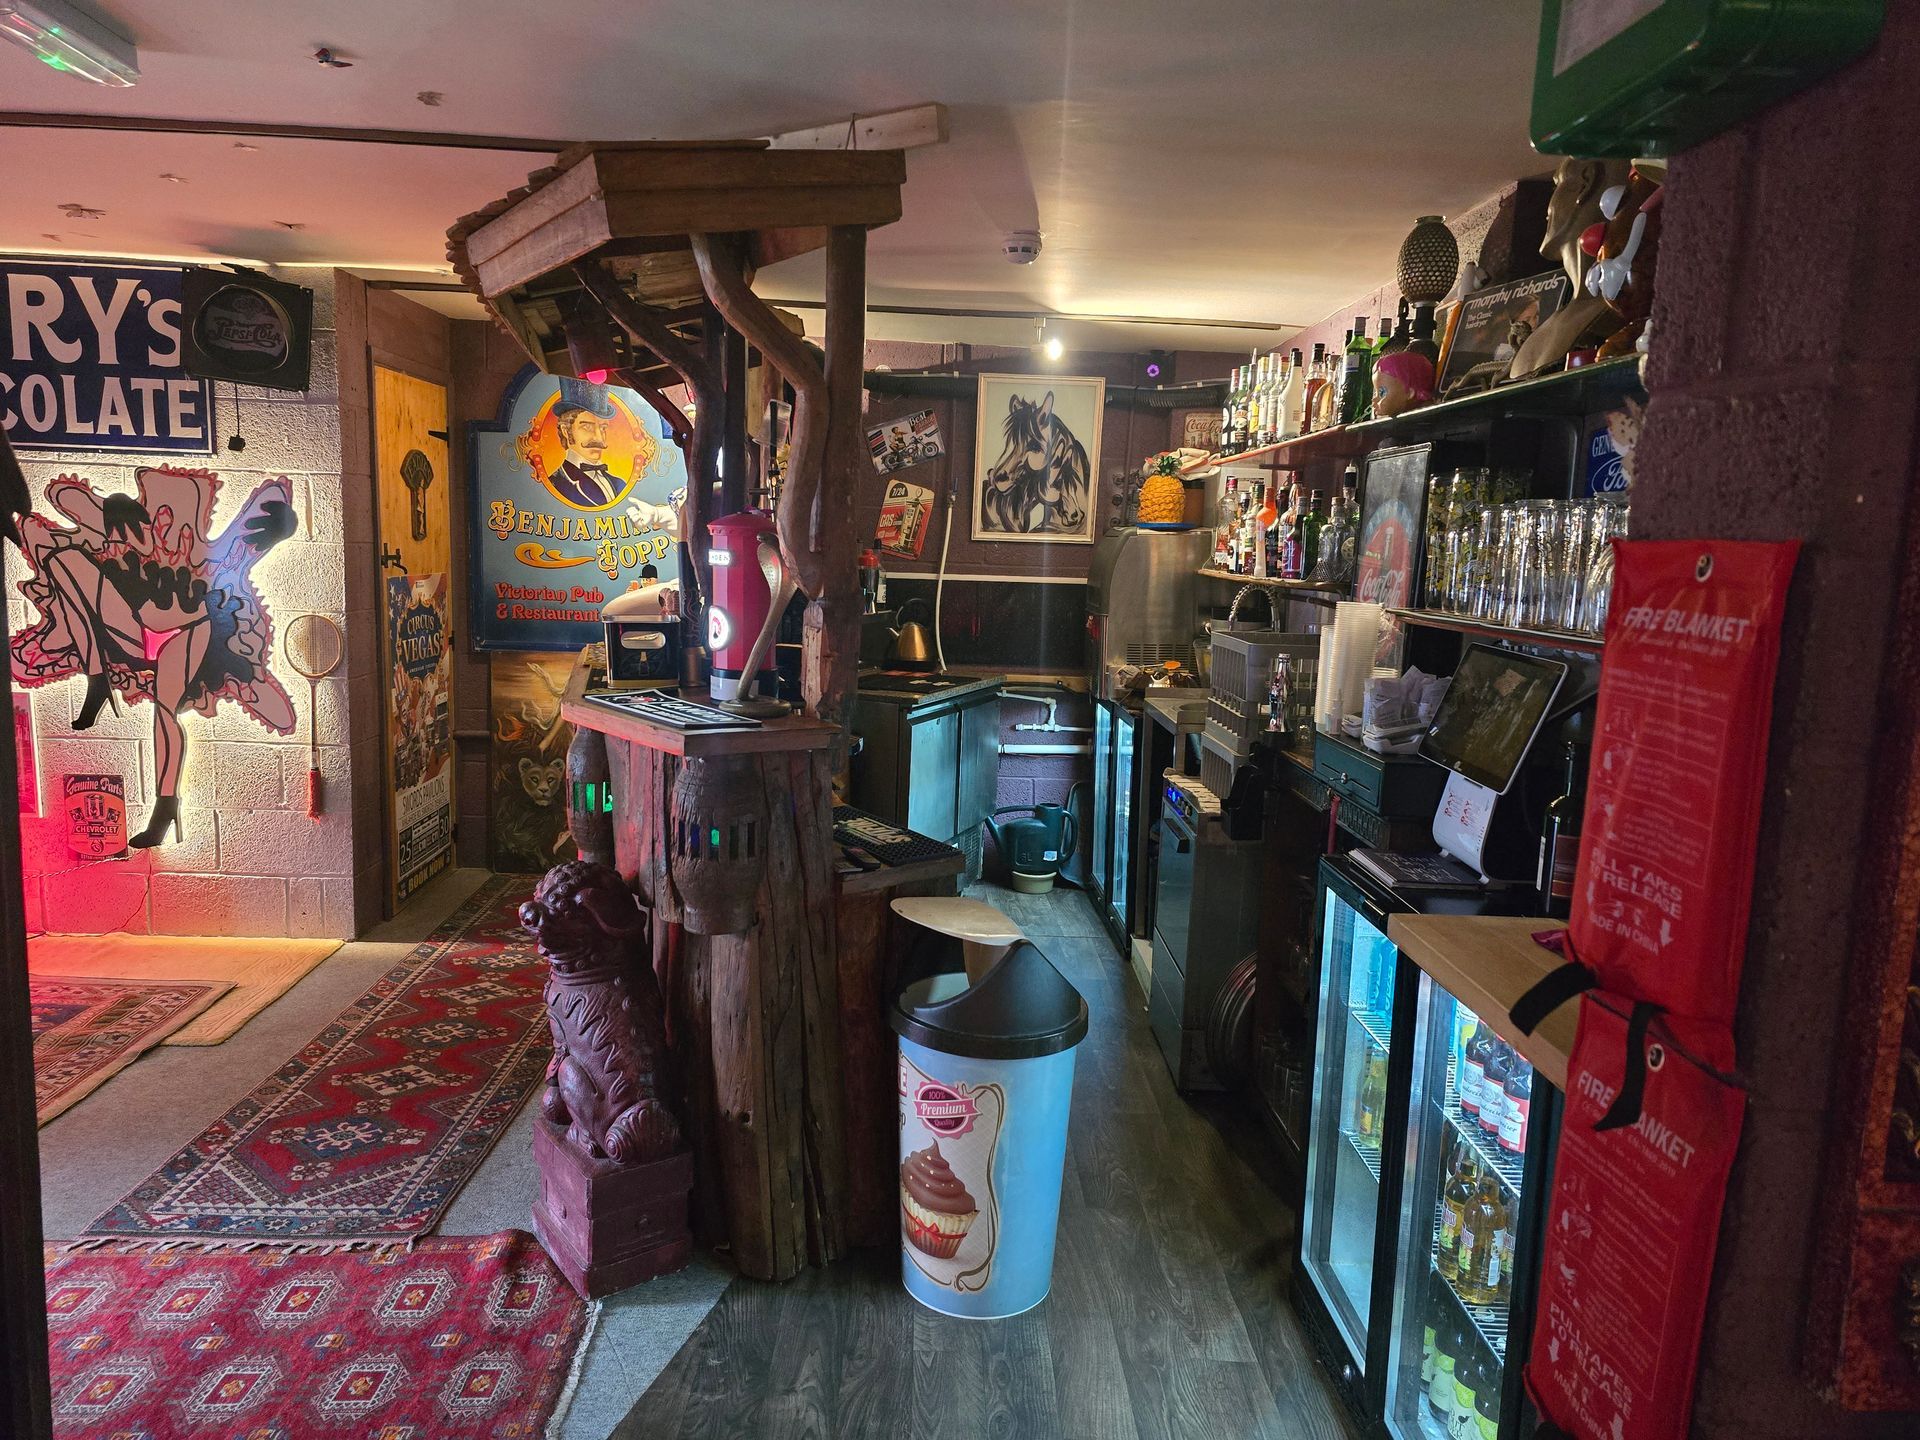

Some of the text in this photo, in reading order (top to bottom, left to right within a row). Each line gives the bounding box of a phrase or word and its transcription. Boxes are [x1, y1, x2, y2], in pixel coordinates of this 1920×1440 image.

[1470, 274, 1559, 309] morphy richards
[1465, 319, 1489, 330] hairdryer
[909, 411, 927, 426] Best
[488, 499, 657, 541] BENJAMI
[880, 514, 895, 528] GAS
[597, 535, 678, 580] TOPP
[495, 582, 604, 604] Victorian Pub
[496, 602, 600, 622] & Restaurant
[407, 615, 435, 634] CIRCUS
[1623, 607, 1750, 643] FIRE BLANKET
[402, 633, 440, 662] VEGAS
[66, 777, 123, 795] Genuine Parts
[439, 815, 449, 838] 30
[400, 840, 411, 865] 25
[408, 866, 429, 892] BOOK
[1628, 863, 1682, 902] TAPES
[1602, 870, 1682, 920] RELEASE
[1616, 922, 1632, 938] IN
[928, 1090, 946, 1100] 100%
[920, 1101, 968, 1116] Premium
[1578, 1070, 1616, 1109] FIRE
[1631, 1110, 1696, 1168] ANKET
[933, 1118, 955, 1128] Quality
[1550, 1302, 1582, 1342] PULL
[1584, 1342, 1633, 1404] TAPES
[1549, 1312, 1567, 1341] TO
[1568, 1338, 1633, 1421] RELEASE
